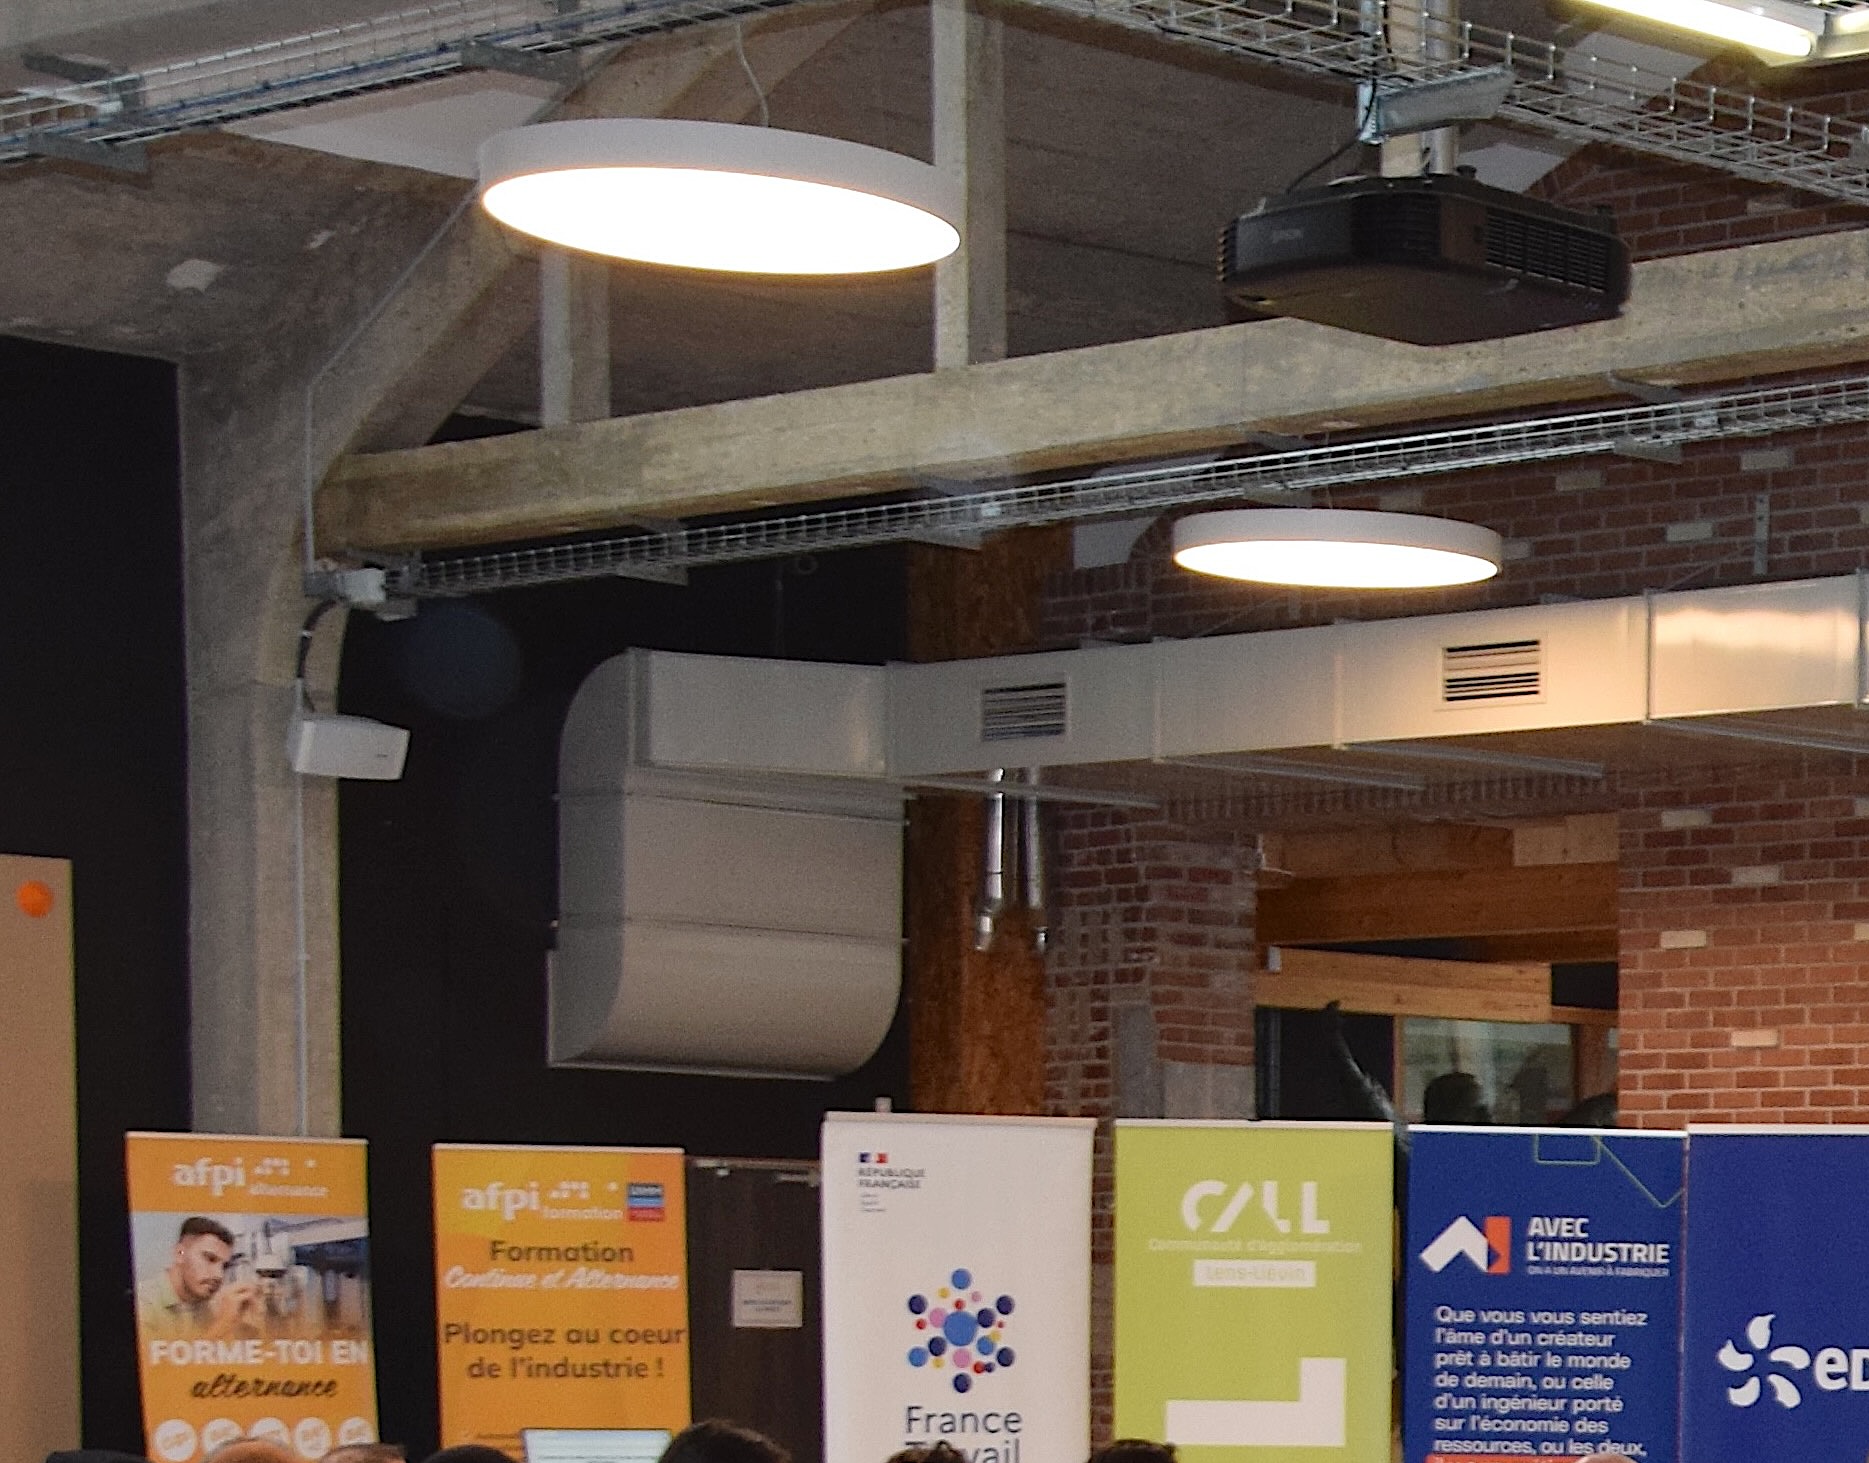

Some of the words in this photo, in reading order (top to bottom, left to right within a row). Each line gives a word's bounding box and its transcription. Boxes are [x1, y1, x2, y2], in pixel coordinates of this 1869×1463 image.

[173, 1157, 246, 1196] afpi
[858, 1166, 926, 1178] RÉPUBLIQUE
[858, 1178, 921, 1190] FRANÇAISE
[461, 1181, 540, 1220] afpi
[544, 1208, 624, 1220] formation
[1527, 1216, 1589, 1238] AVEC
[489, 1240, 634, 1262] Formation
[1526, 1241, 1671, 1264] L'INDUSTRIE
[1435, 1305, 1475, 1324] Que
[1481, 1310, 1525, 1325] vous
[1531, 1310, 1575, 1325] vous
[1580, 1309, 1648, 1326] sentiez
[445, 1323, 555, 1349] Plongez
[566, 1328, 600, 1344] au
[609, 1327, 686, 1344] coeur
[1434, 1328, 1485, 1345] l'âme
[1491, 1328, 1531, 1345] d'un
[1536, 1330, 1616, 1347] créateur
[150, 1339, 322, 1366] FORME-TOI
[332, 1339, 369, 1366] EN
[1434, 1351, 1474, 1370] prêt
[1479, 1352, 1492, 1367] à
[1496, 1351, 1541, 1368] bâtir
[1546, 1351, 1563, 1368] le
[1568, 1353, 1632, 1370] monde
[467, 1356, 502, 1379] de
[510, 1356, 649, 1379] l'industrie
[655, 1357, 665, 1377] !
[191, 1373, 338, 1398] alternance
[1434, 1372, 1459, 1389] de
[1464, 1372, 1537, 1391] demain,
[1542, 1376, 1566, 1389] ou
[1571, 1374, 1614, 1390] celle
[1434, 1392, 1476, 1409] d'un
[1481, 1393, 1567, 1414] ingénieur
[1572, 1395, 1623, 1415] porté
[906, 1406, 1022, 1434] France
[1434, 1416, 1465, 1431] sur
[1470, 1414, 1570, 1432] l'économie
[1575, 1416, 1609, 1433] des
[1434, 1440, 1537, 1455] ressources,
[1540, 1441, 1564, 1454] ou
[1569, 1438, 1594, 1454] les
